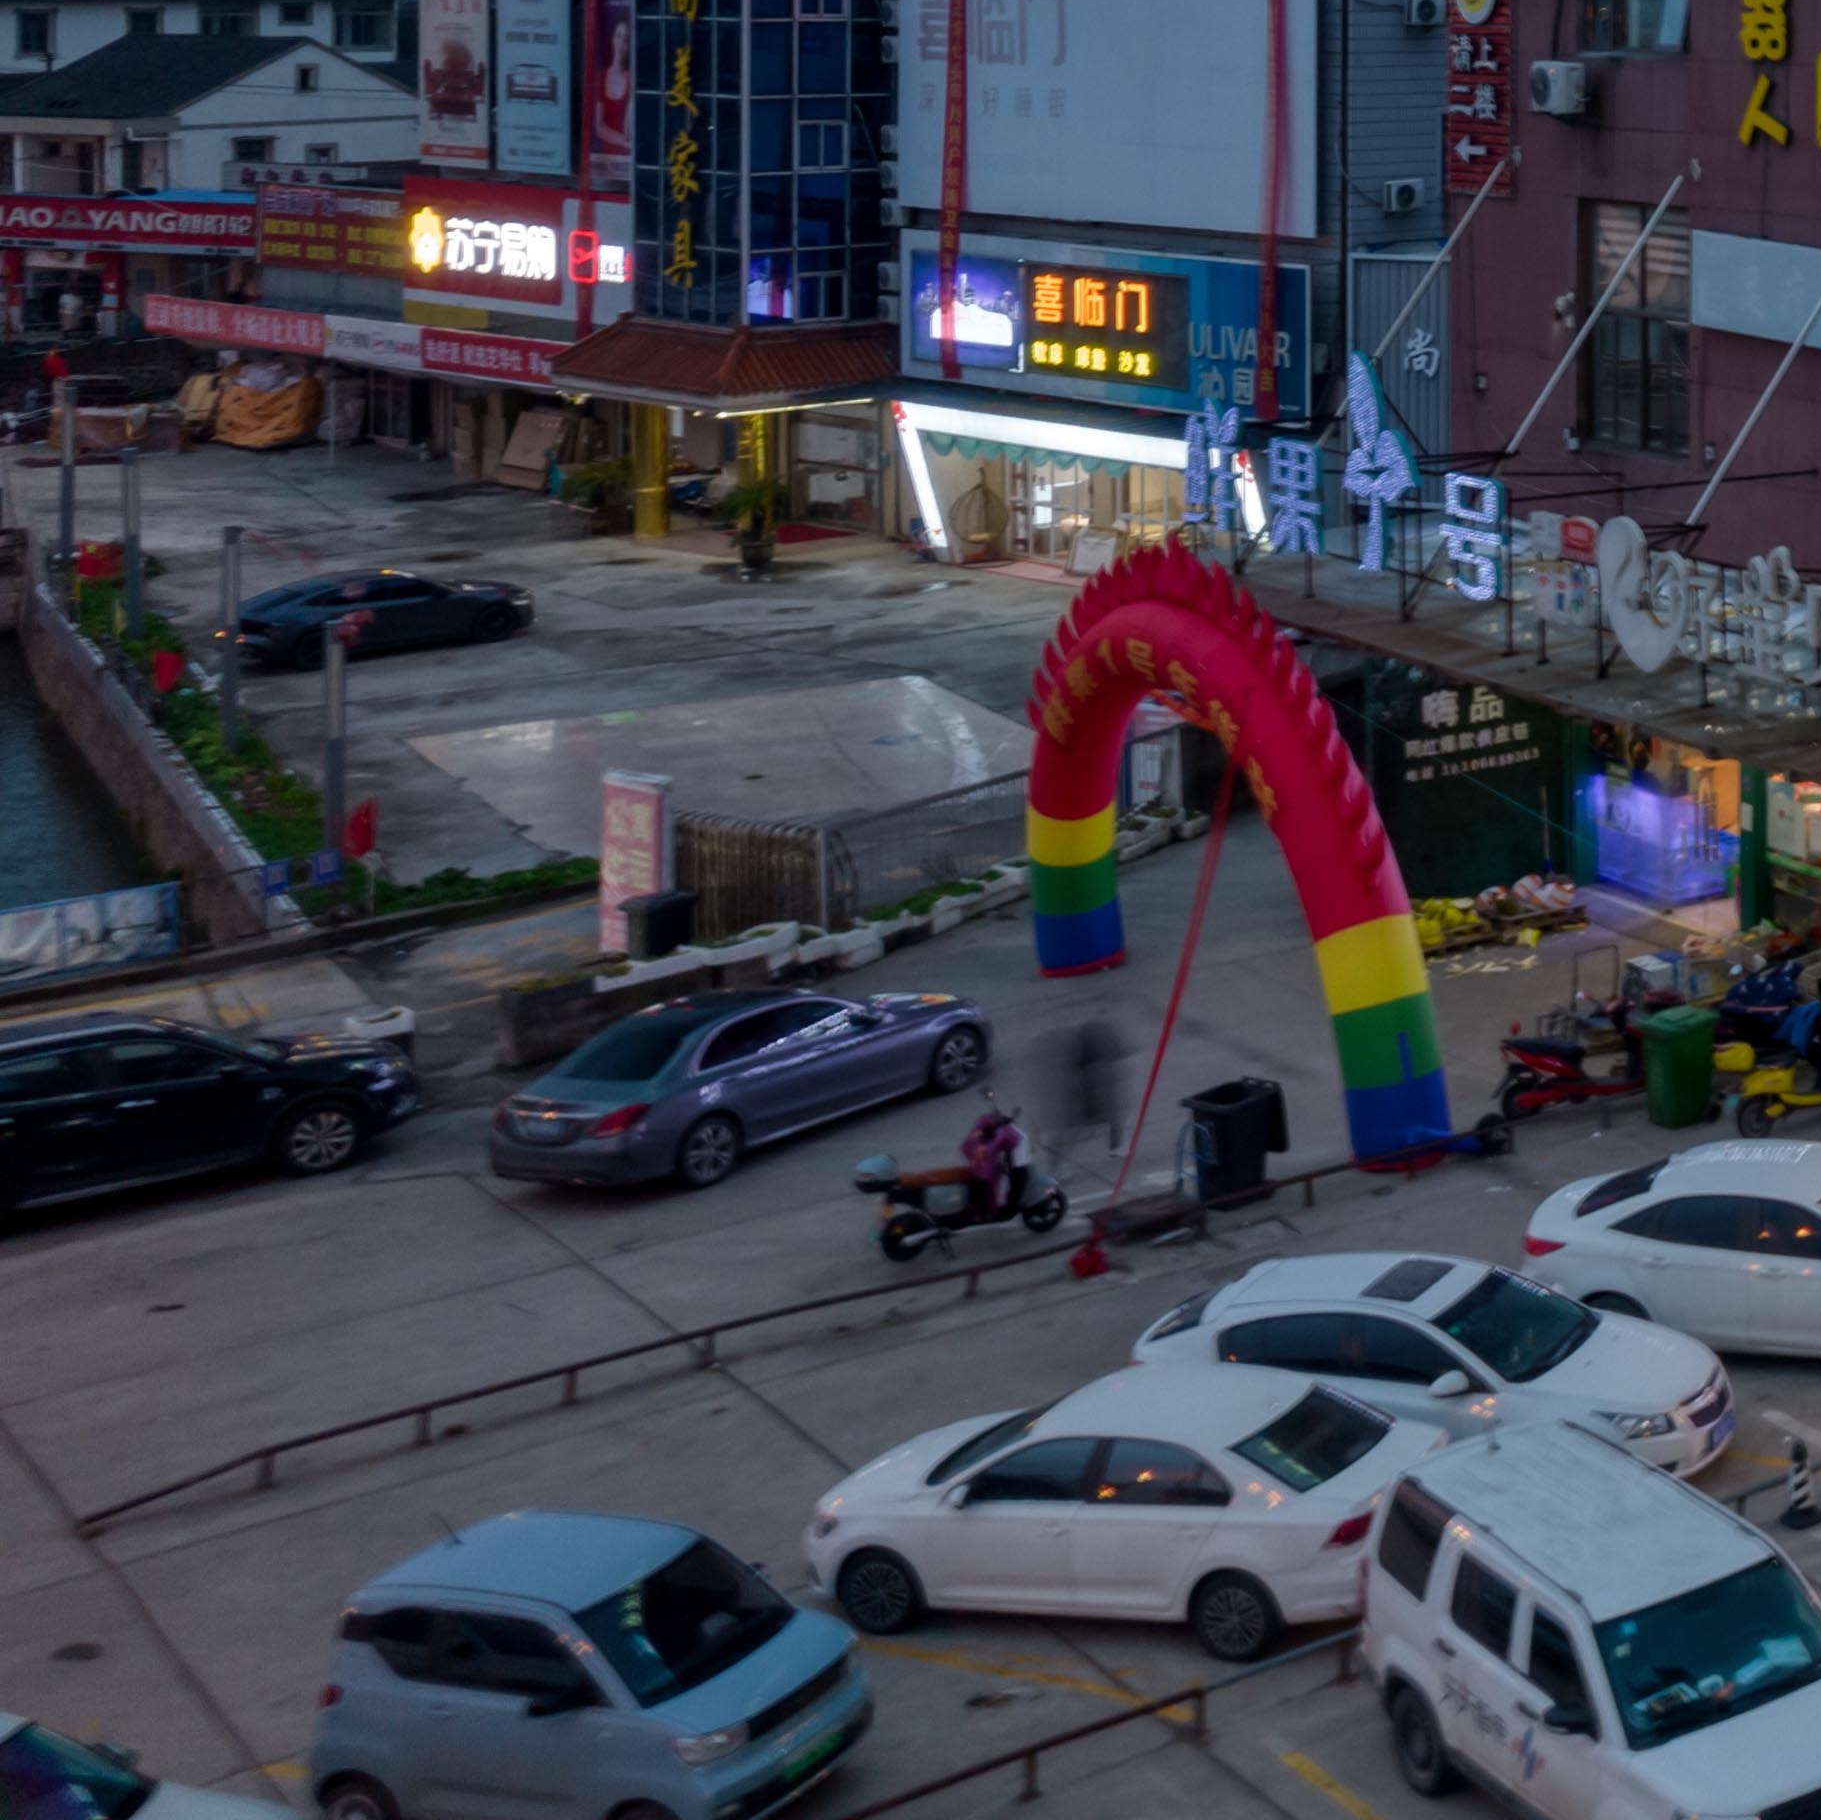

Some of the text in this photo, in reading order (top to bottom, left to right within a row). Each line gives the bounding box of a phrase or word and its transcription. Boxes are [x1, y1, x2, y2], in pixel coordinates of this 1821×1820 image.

[918, 83, 1068, 120] 深好睡眠
[0, 206, 56, 230] AO
[87, 209, 177, 234] YANG
[444, 217, 557, 281] 苏宁易购
[1031, 273, 1152, 334] 喜临门
